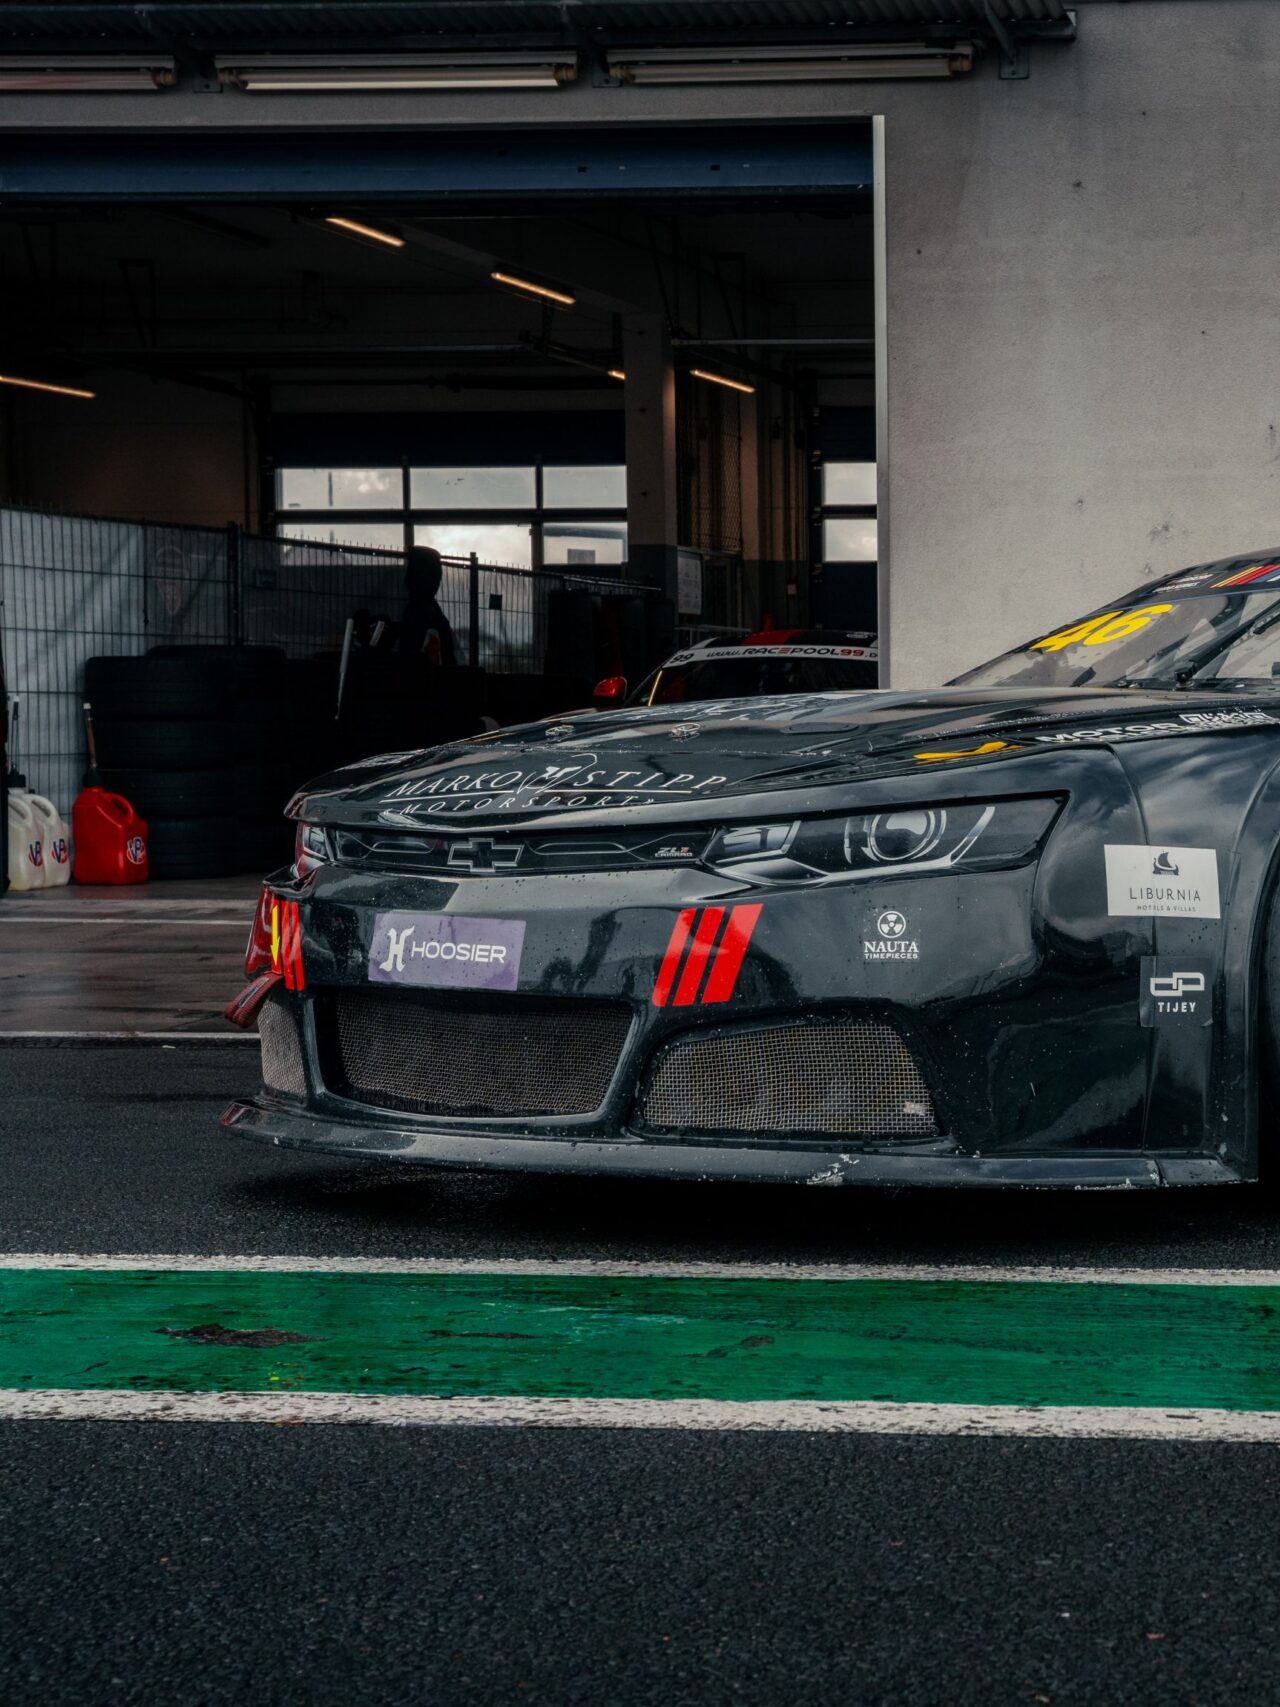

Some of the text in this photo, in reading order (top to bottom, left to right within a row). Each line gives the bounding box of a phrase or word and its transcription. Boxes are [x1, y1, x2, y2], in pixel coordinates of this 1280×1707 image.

[1028, 603, 1173, 652] 46
[670, 652, 694, 664] 99
[386, 770, 727, 798] MARKO STIPP
[1129, 887, 1201, 902] LIBURNIA
[411, 941, 507, 964] HOOSIER
[864, 940, 919, 953] NAUTA
[864, 952, 918, 960] TIMEPIECES
[1157, 1001, 1197, 1013] TIJEY
